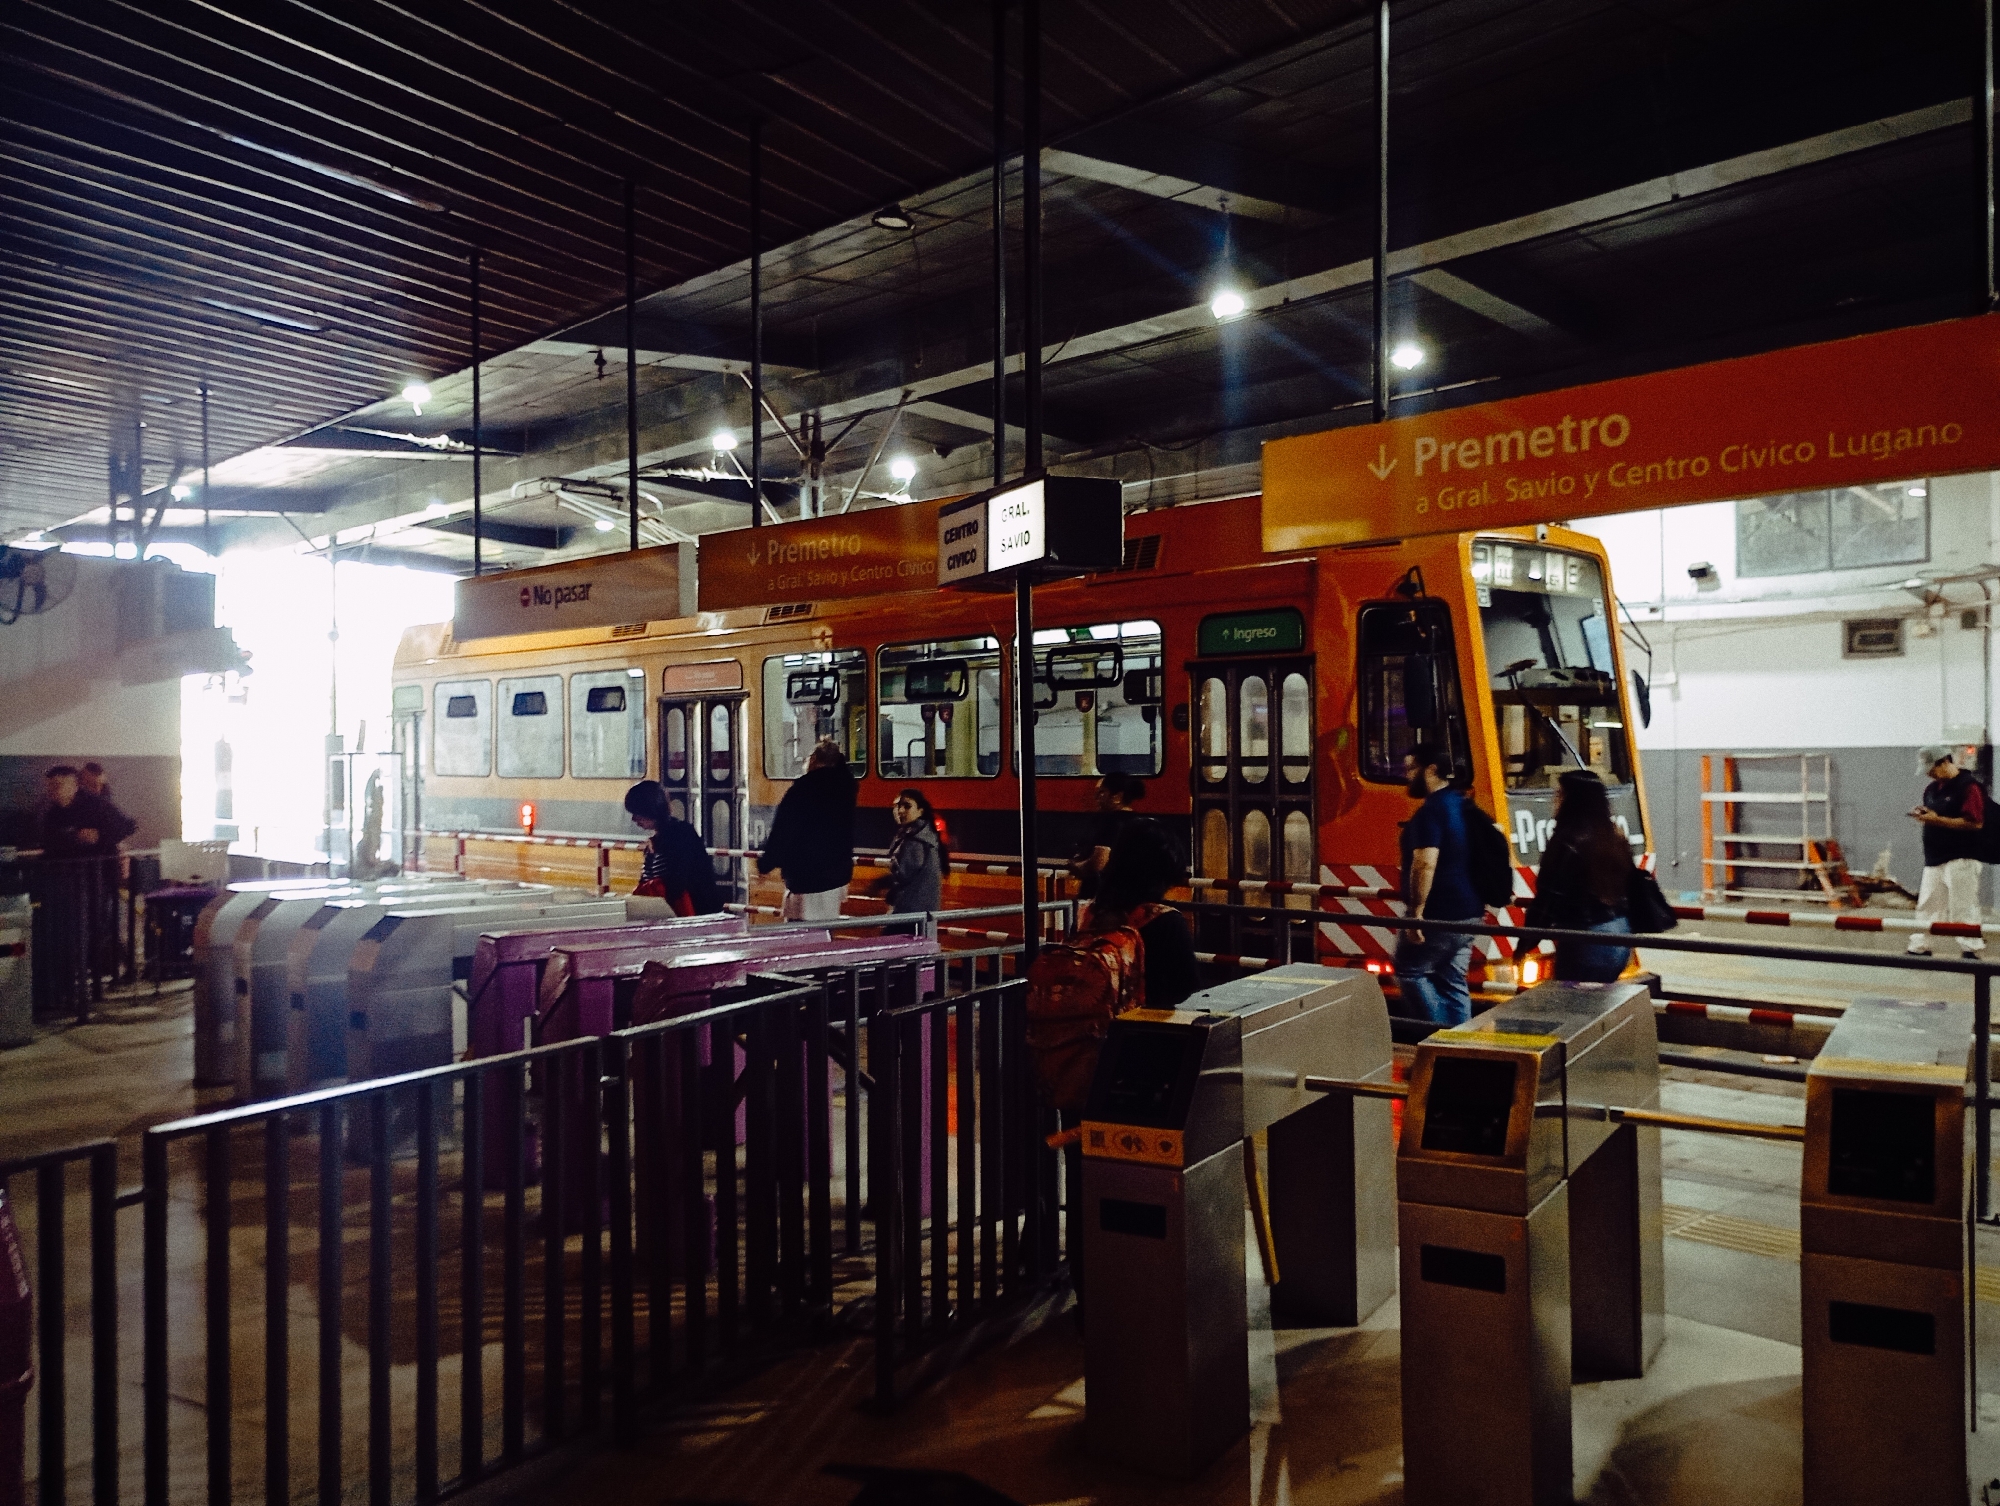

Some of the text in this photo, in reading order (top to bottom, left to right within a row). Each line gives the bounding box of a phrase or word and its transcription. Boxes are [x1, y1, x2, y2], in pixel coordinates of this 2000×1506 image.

[1413, 413, 1631, 477] Premetro
[1415, 496, 1429, 514] a
[1505, 471, 1575, 503] Savio
[1583, 472, 1599, 499] y
[1607, 455, 1710, 488] Centro
[1719, 438, 1816, 473] Cívico
[1828, 422, 1963, 460] Lugano
[1001, 501, 1030, 523] GRAL.
[944, 520, 979, 545] CENTRO
[1001, 530, 1031, 553] SAVIO
[767, 532, 862, 566] Premetro
[767, 580, 775, 591] a
[808, 570, 838, 587] Savio
[838, 570, 848, 588] y
[851, 565, 893, 581] Centro
[534, 583, 593, 609] No pasar
[1233, 627, 1278, 643] Ingreso
